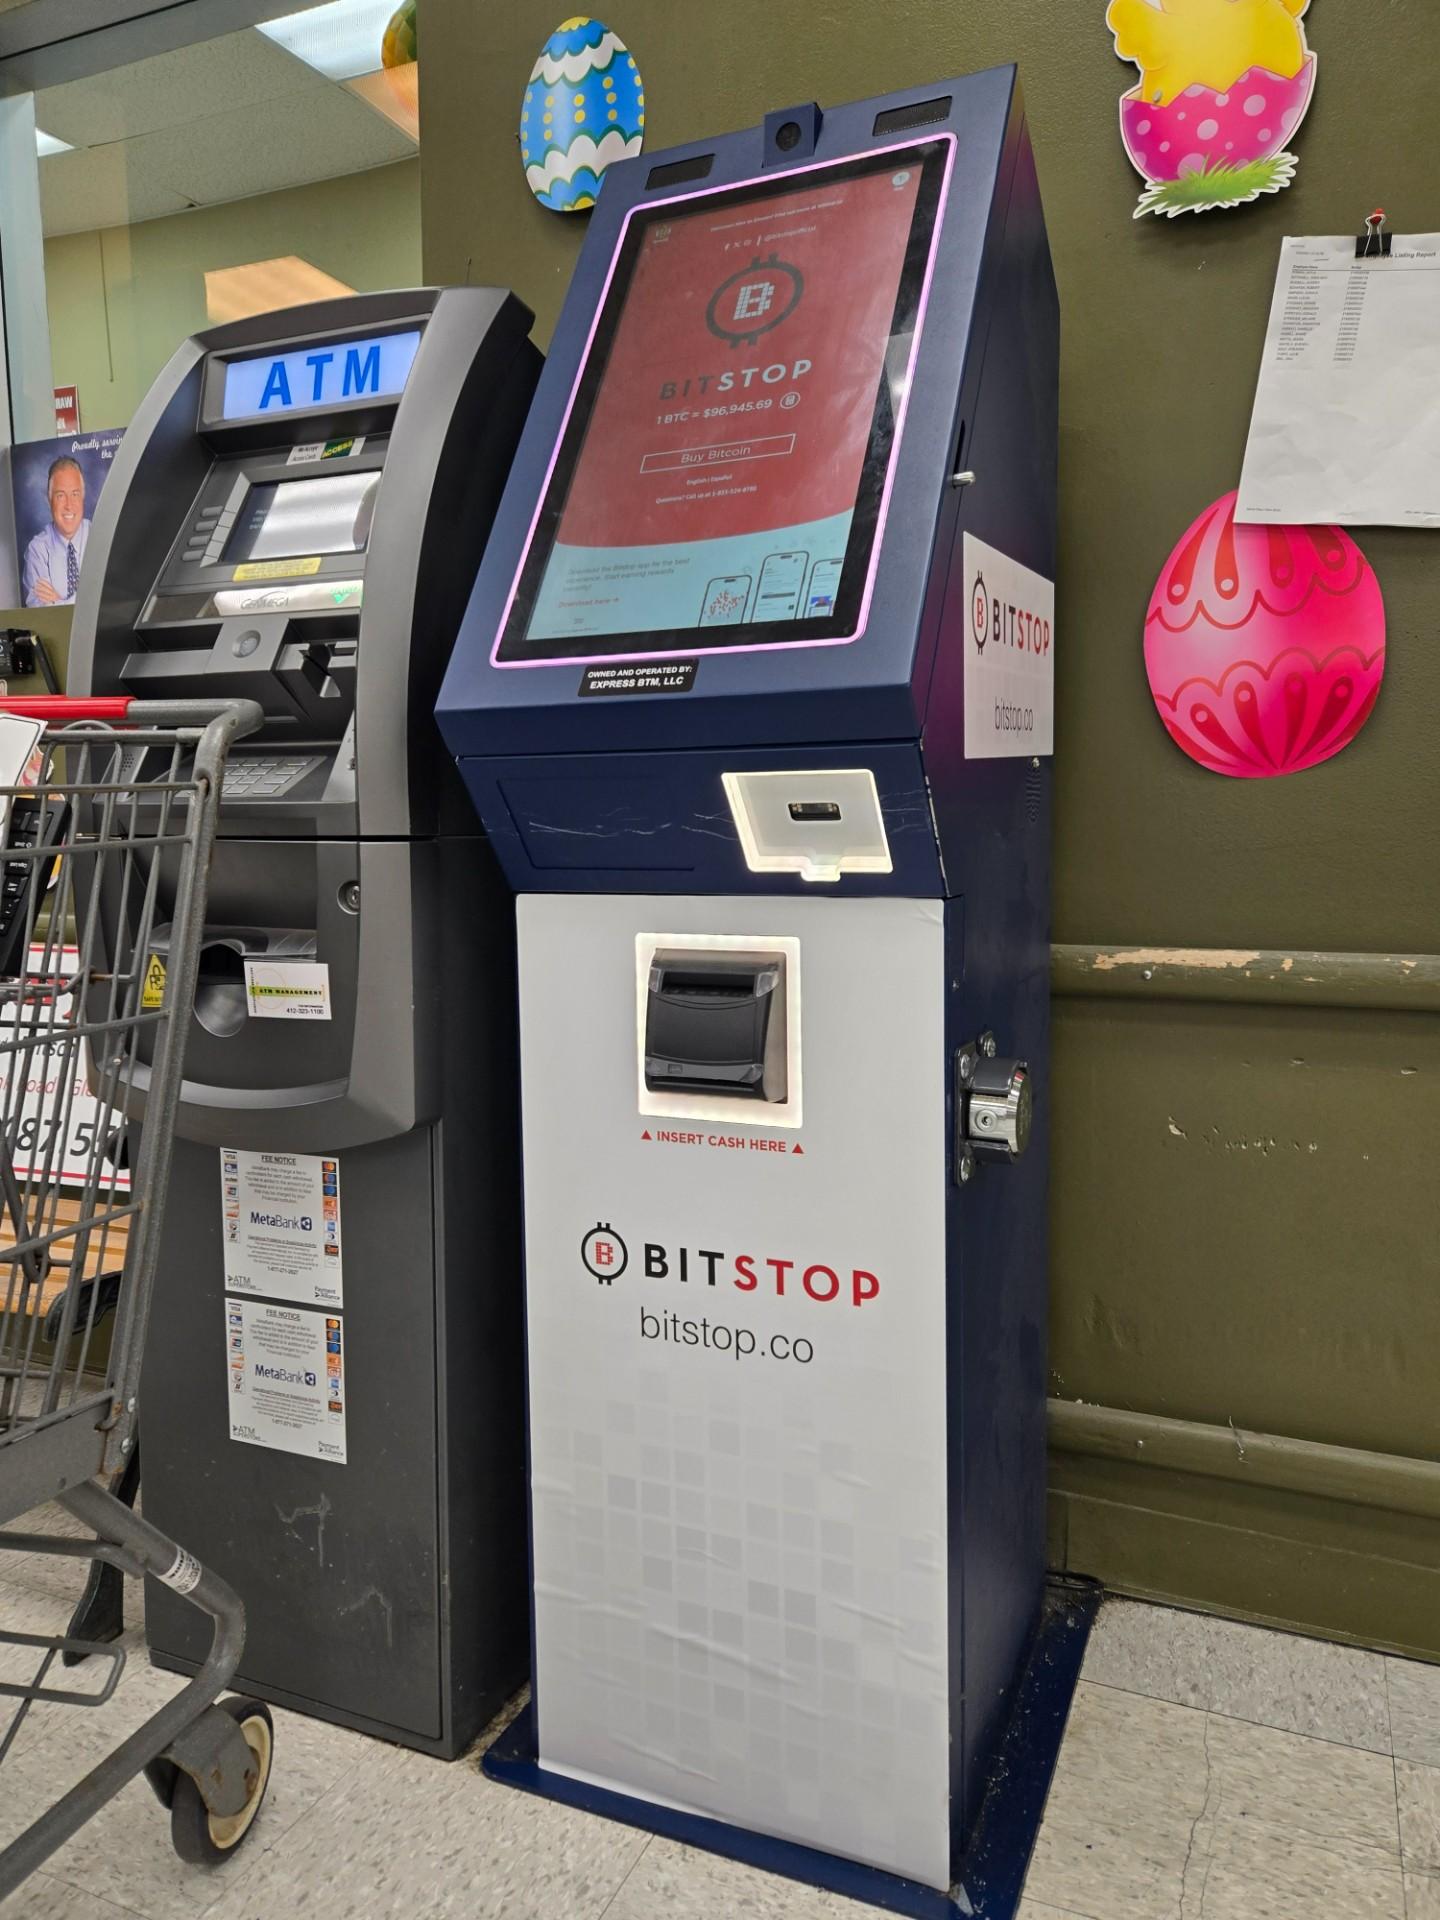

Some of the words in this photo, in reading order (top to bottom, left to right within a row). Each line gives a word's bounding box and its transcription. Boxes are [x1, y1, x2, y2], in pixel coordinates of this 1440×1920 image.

[259, 345, 380, 409] ATM
[660, 359, 812, 400] BITSTOP
[664, 411, 689, 424] BTC
[703, 398, 773, 418] $96,945.69
[680, 453, 704, 465] Buy
[708, 446, 751, 461] Bitcoin
[993, 598, 1050, 656] BITSTOP
[588, 669, 616, 679] OWNED
[617, 668, 634, 677] AND
[635, 666, 678, 676] OPERATED
[679, 664, 693, 673] BY:
[589, 679, 636, 690] EXPRESS
[637, 677, 661, 688] BTM,
[663, 675, 684, 685] LLC
[994, 696, 1034, 738] bitstop.co
[275, 989, 322, 997] MANAGEMENT
[656, 1130, 704, 1145] INSERT
[708, 1135, 745, 1149] CASH
[749, 1139, 787, 1153] HERE
[261, 1155, 273, 1163] FEE
[274, 1157, 297, 1166] NOTICE
[250, 1212, 300, 1230] MetaBank
[234, 1275, 251, 1285] ATM
[644, 1243, 880, 1307] BITSTOP
[315, 1285, 336, 1294] Payment
[278, 1311, 301, 1322] NOTICE
[640, 1306, 814, 1364] bitstop.co
[255, 1364, 303, 1385] MetaBank
[239, 1425, 255, 1434] ATM
[318, 1441, 340, 1450] Payment
